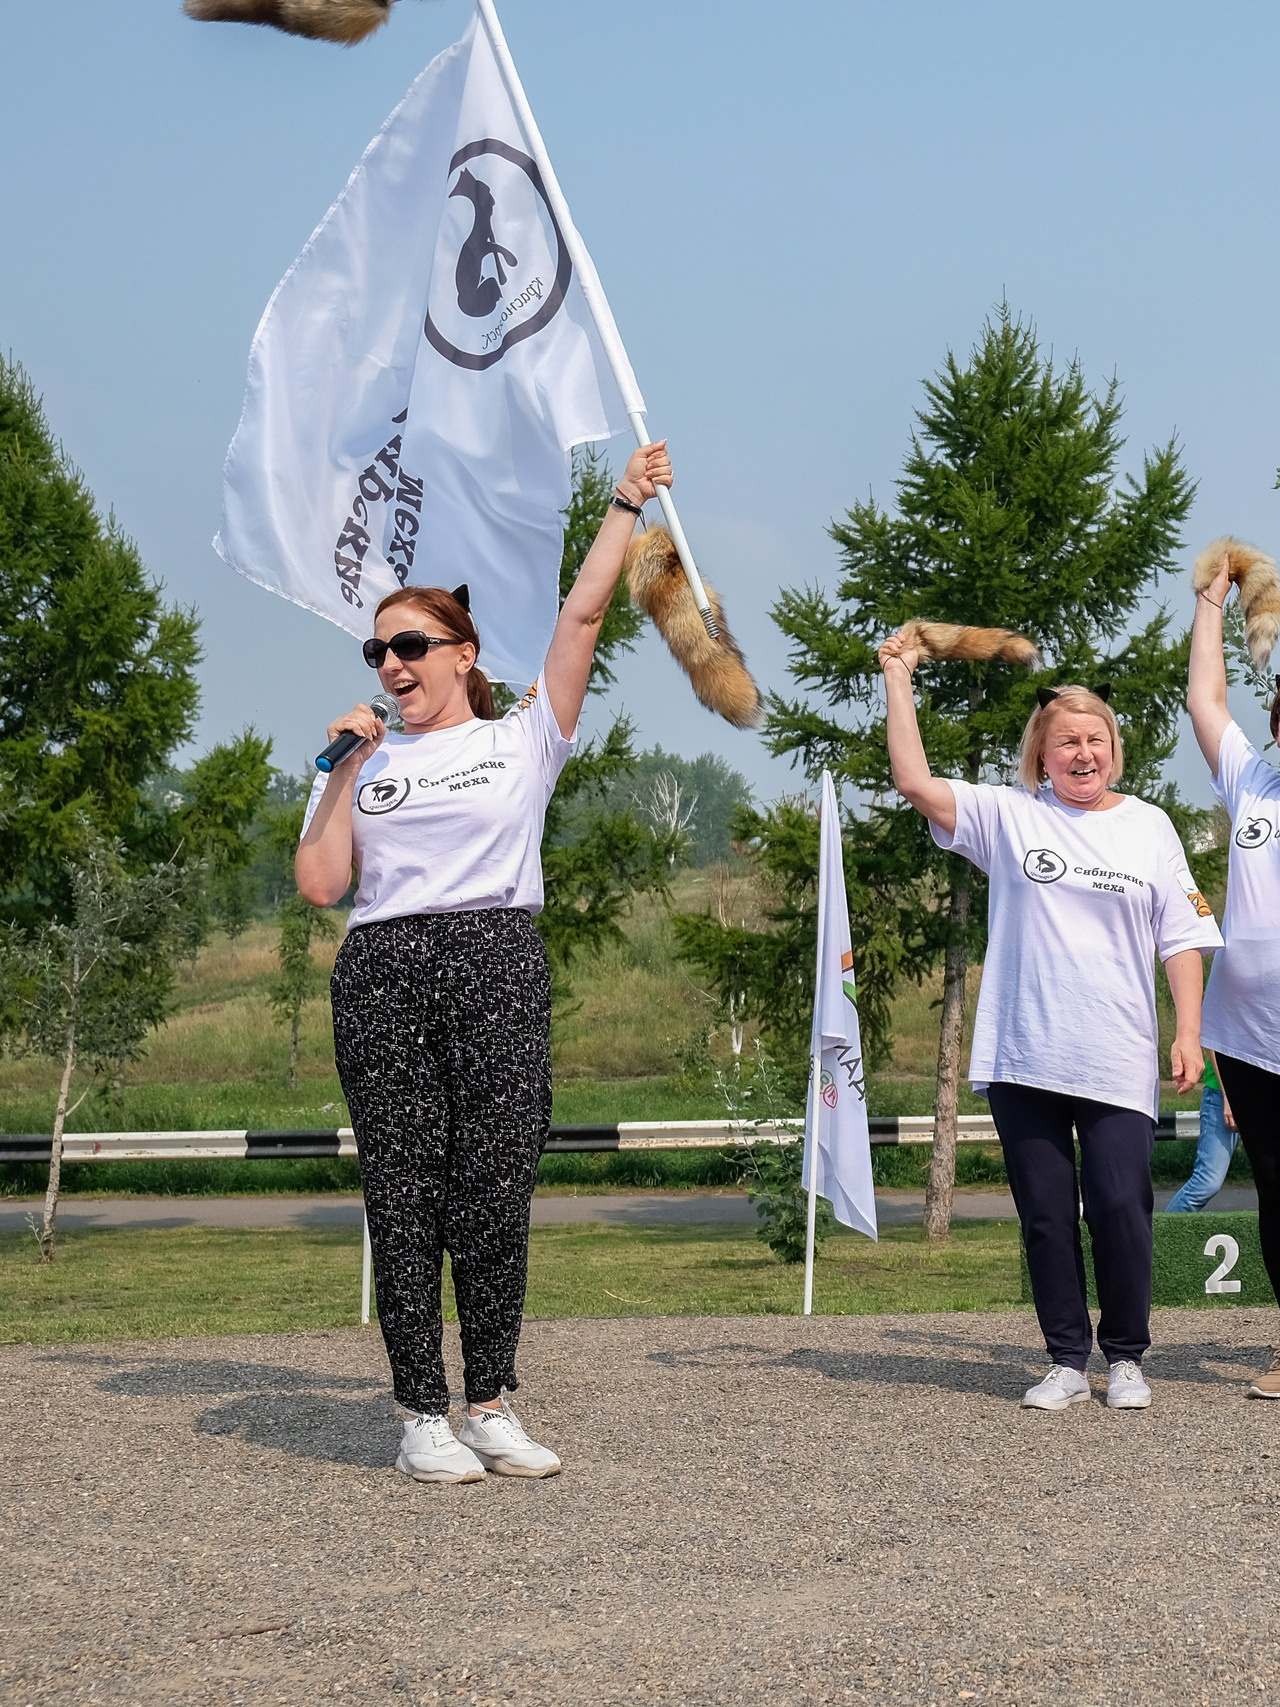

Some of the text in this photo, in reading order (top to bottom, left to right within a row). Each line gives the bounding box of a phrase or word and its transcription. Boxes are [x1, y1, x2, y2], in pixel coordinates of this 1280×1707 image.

[449, 775, 490, 792] меха
[1073, 866, 1144, 888] Сибирские
[1092, 880, 1125, 894] меха
[1203, 1233, 1242, 1294] 2
